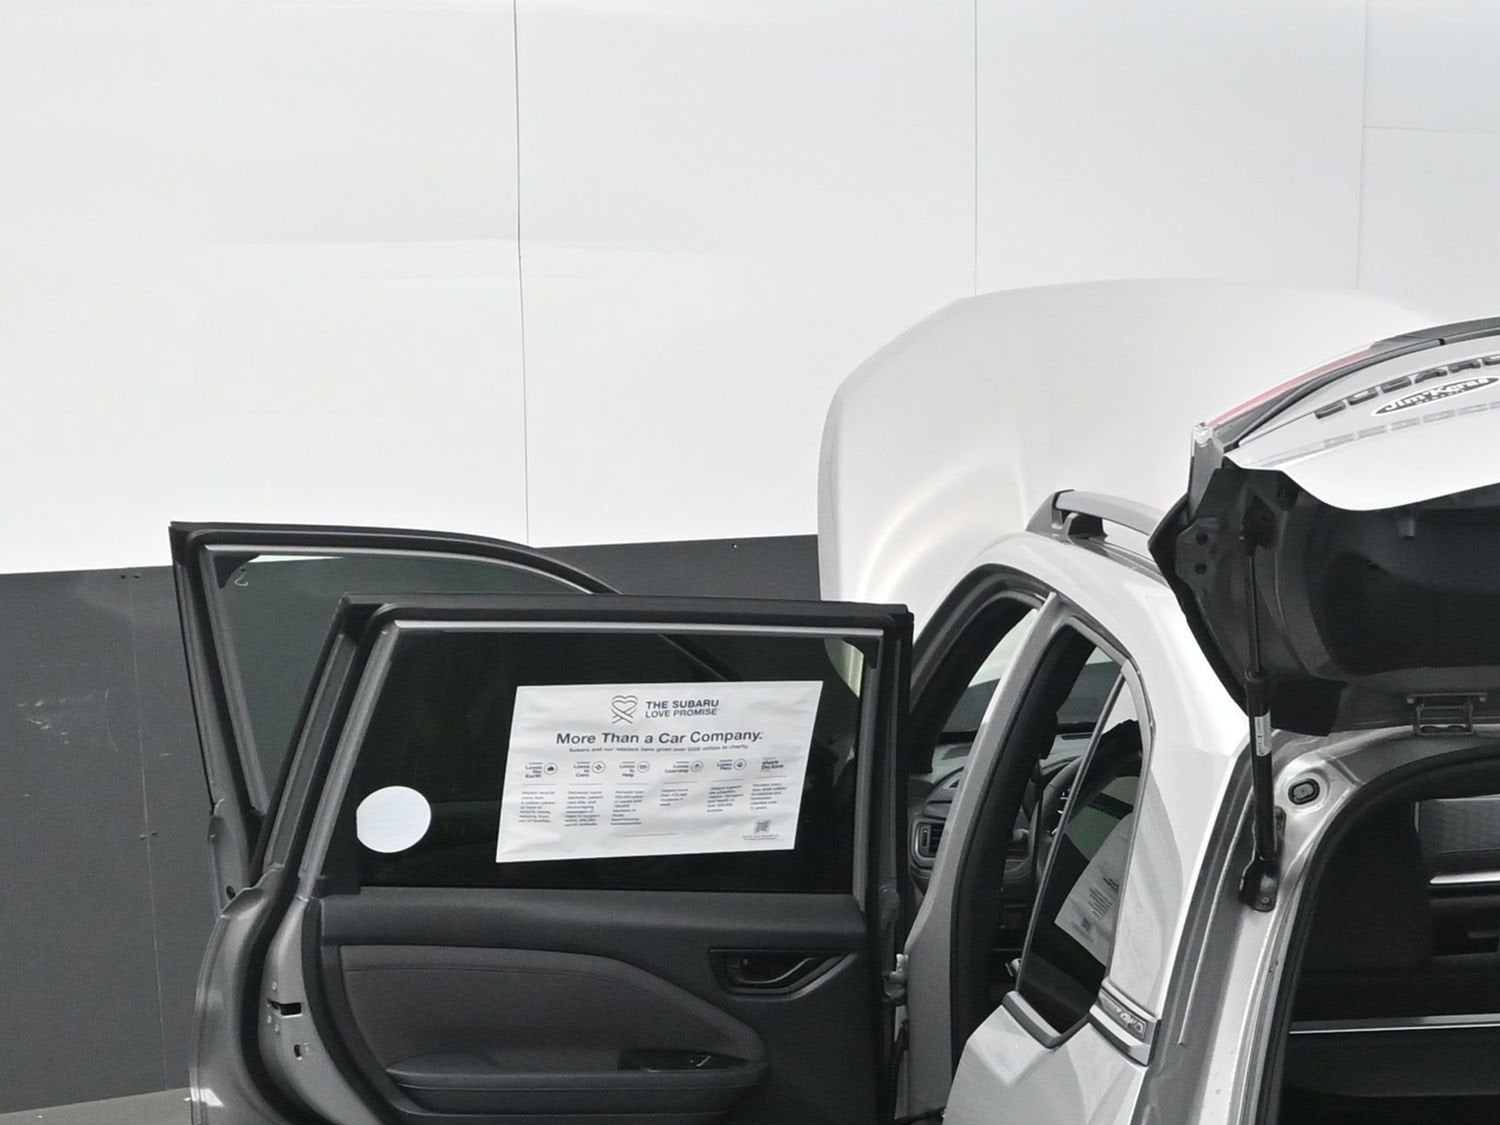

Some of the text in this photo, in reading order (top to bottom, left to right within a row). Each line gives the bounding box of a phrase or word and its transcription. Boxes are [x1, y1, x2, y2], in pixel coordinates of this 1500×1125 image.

[645, 699, 720, 710] THE SUBARU
[645, 708, 719, 718] LOVE PROMISE
[556, 730, 763, 744] More Than a Car Company.
